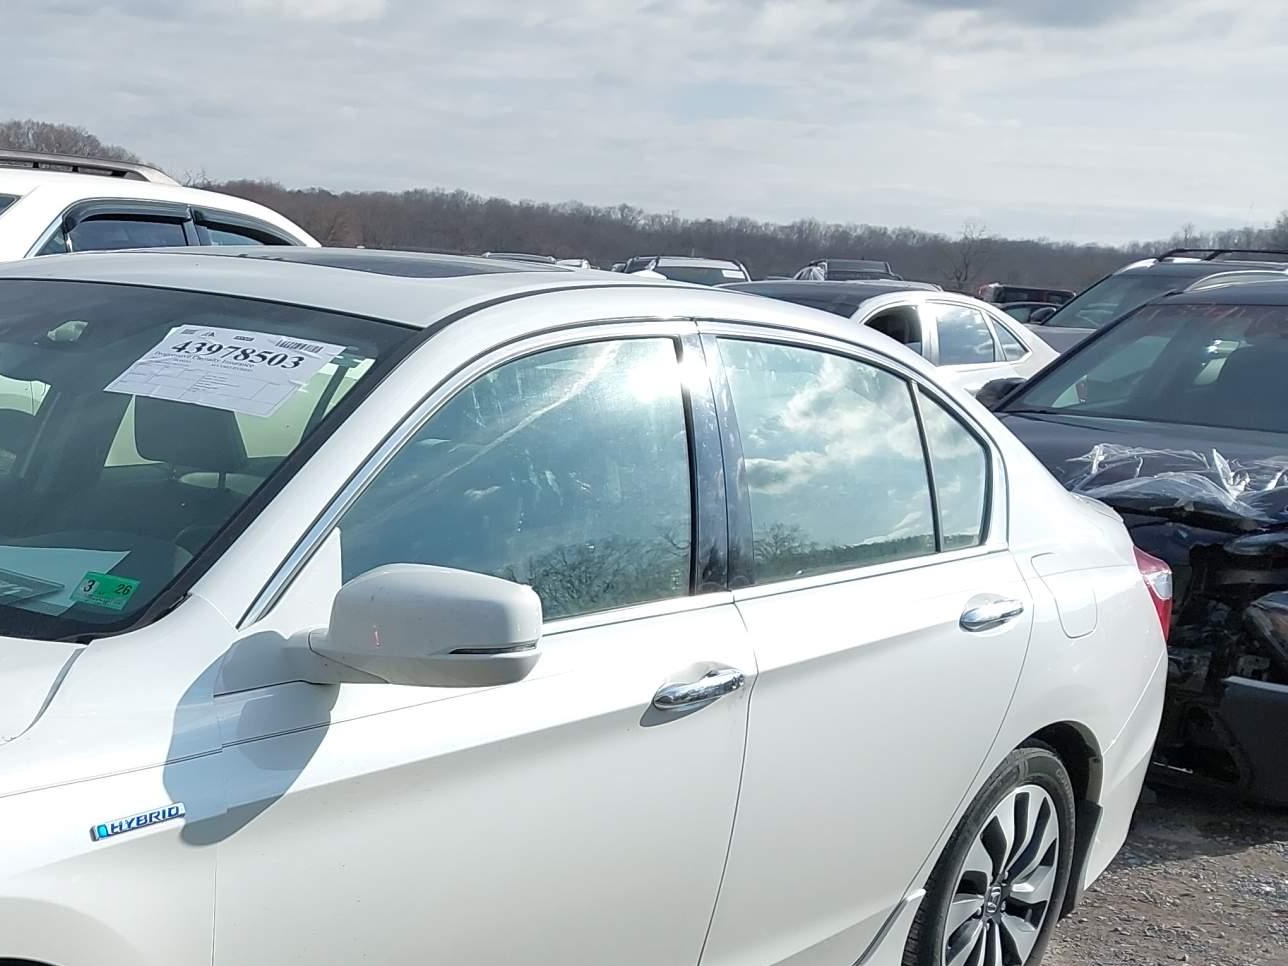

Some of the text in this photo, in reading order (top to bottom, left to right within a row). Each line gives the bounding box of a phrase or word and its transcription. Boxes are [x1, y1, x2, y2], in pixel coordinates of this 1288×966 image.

[172, 340, 305, 369] 43978503
[83, 579, 133, 595] 3 26
[110, 806, 179, 833] HYBRID
